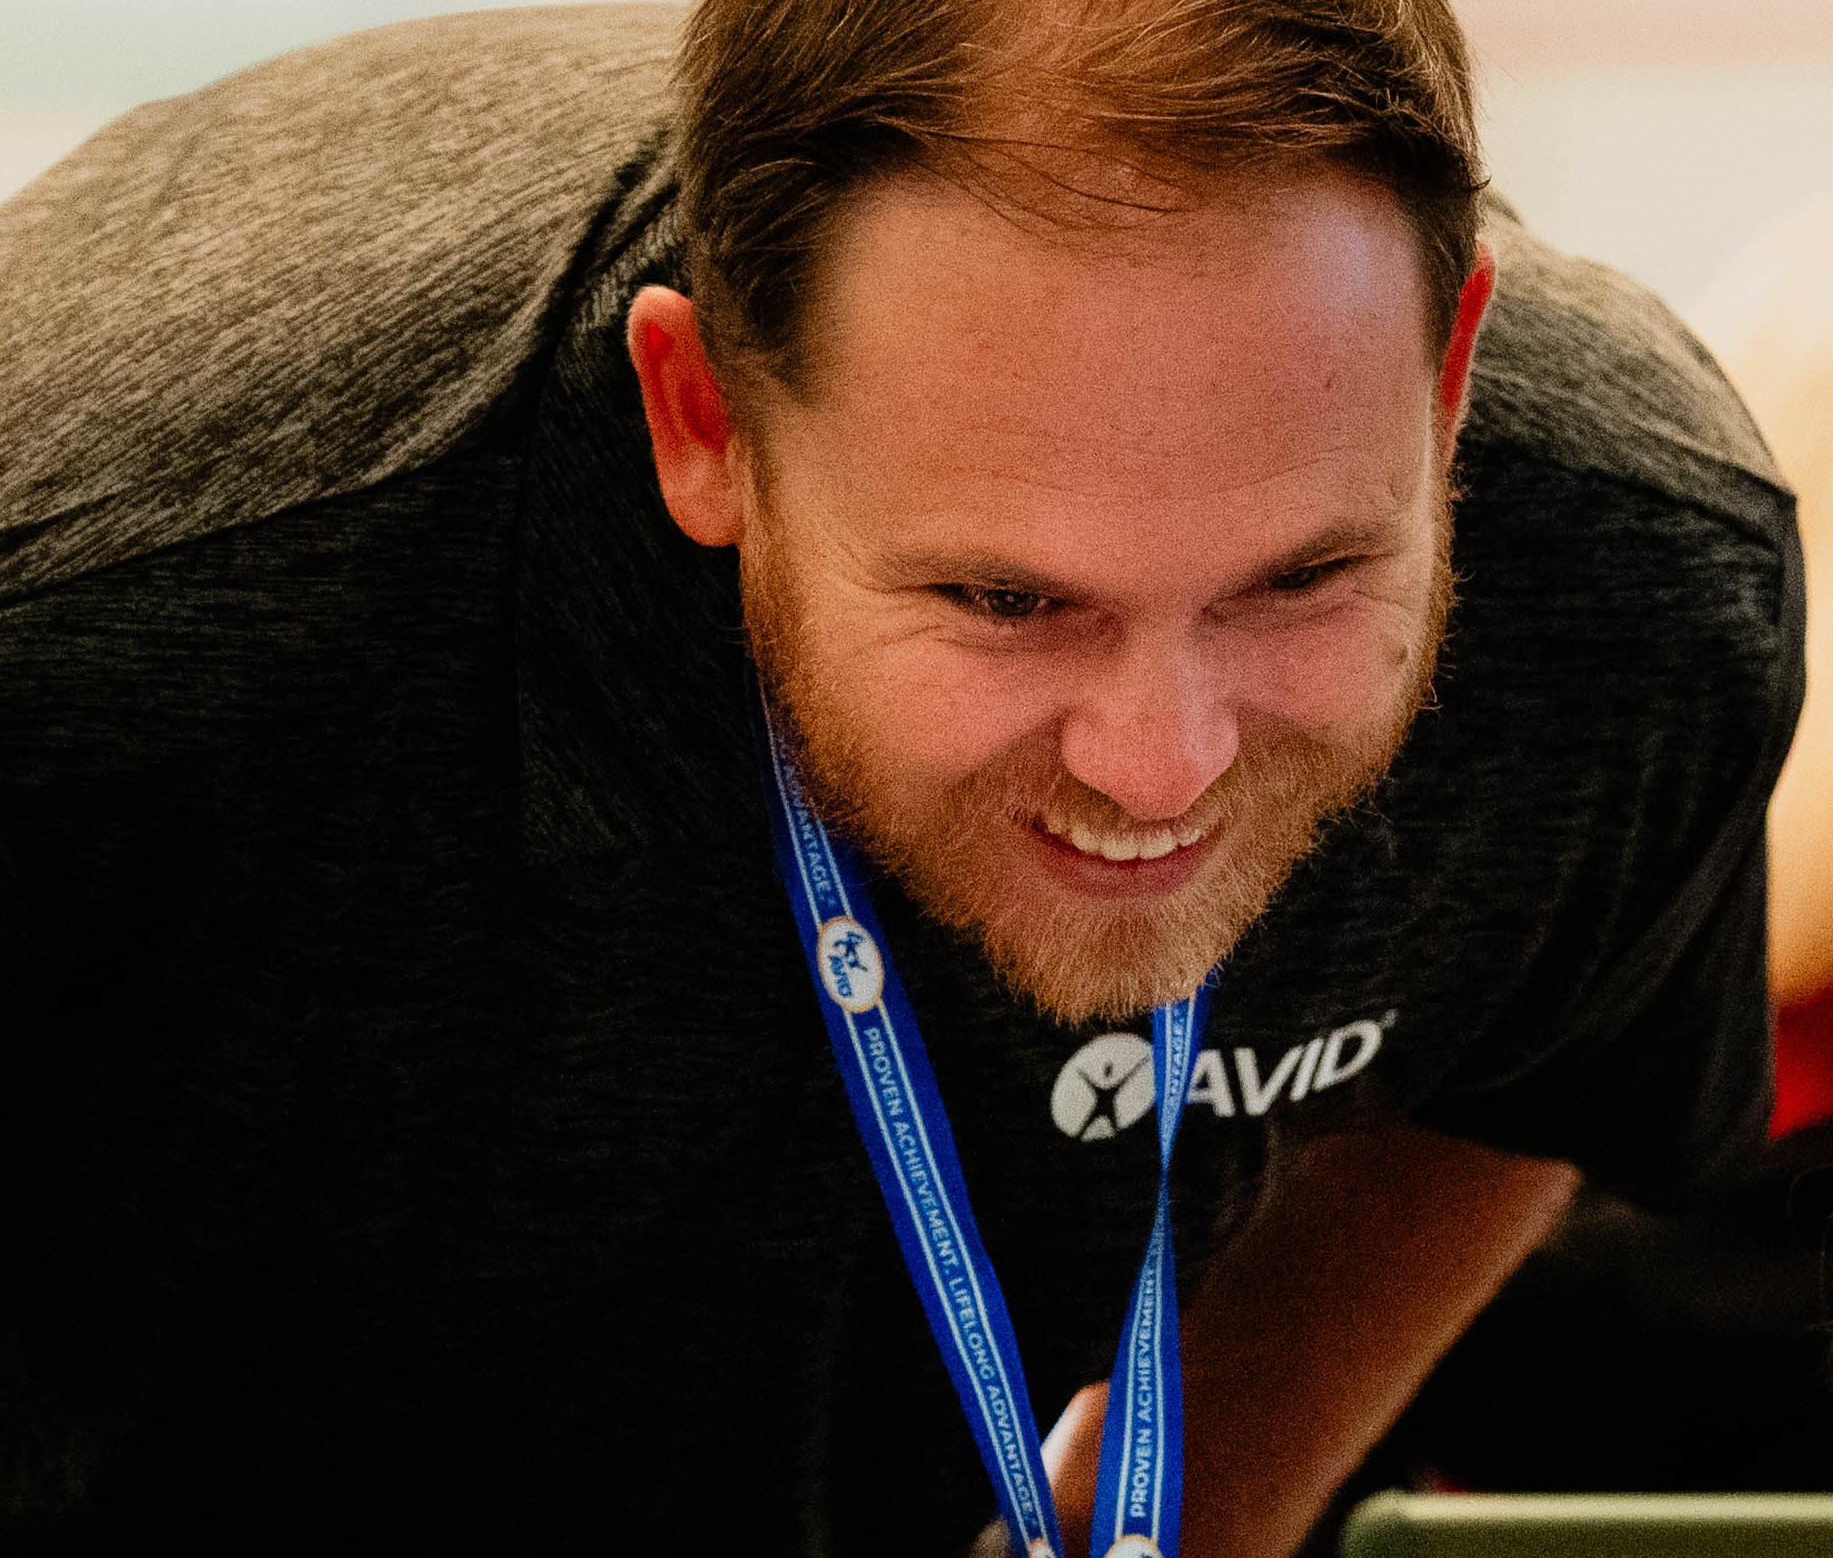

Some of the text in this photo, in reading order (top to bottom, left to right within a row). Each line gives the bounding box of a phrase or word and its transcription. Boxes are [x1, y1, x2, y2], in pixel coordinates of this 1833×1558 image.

[864, 1026, 904, 1116] PROVEN
[949, 1277, 996, 1380] LIFELONG
[1130, 1427, 1153, 1518] PROVEN
